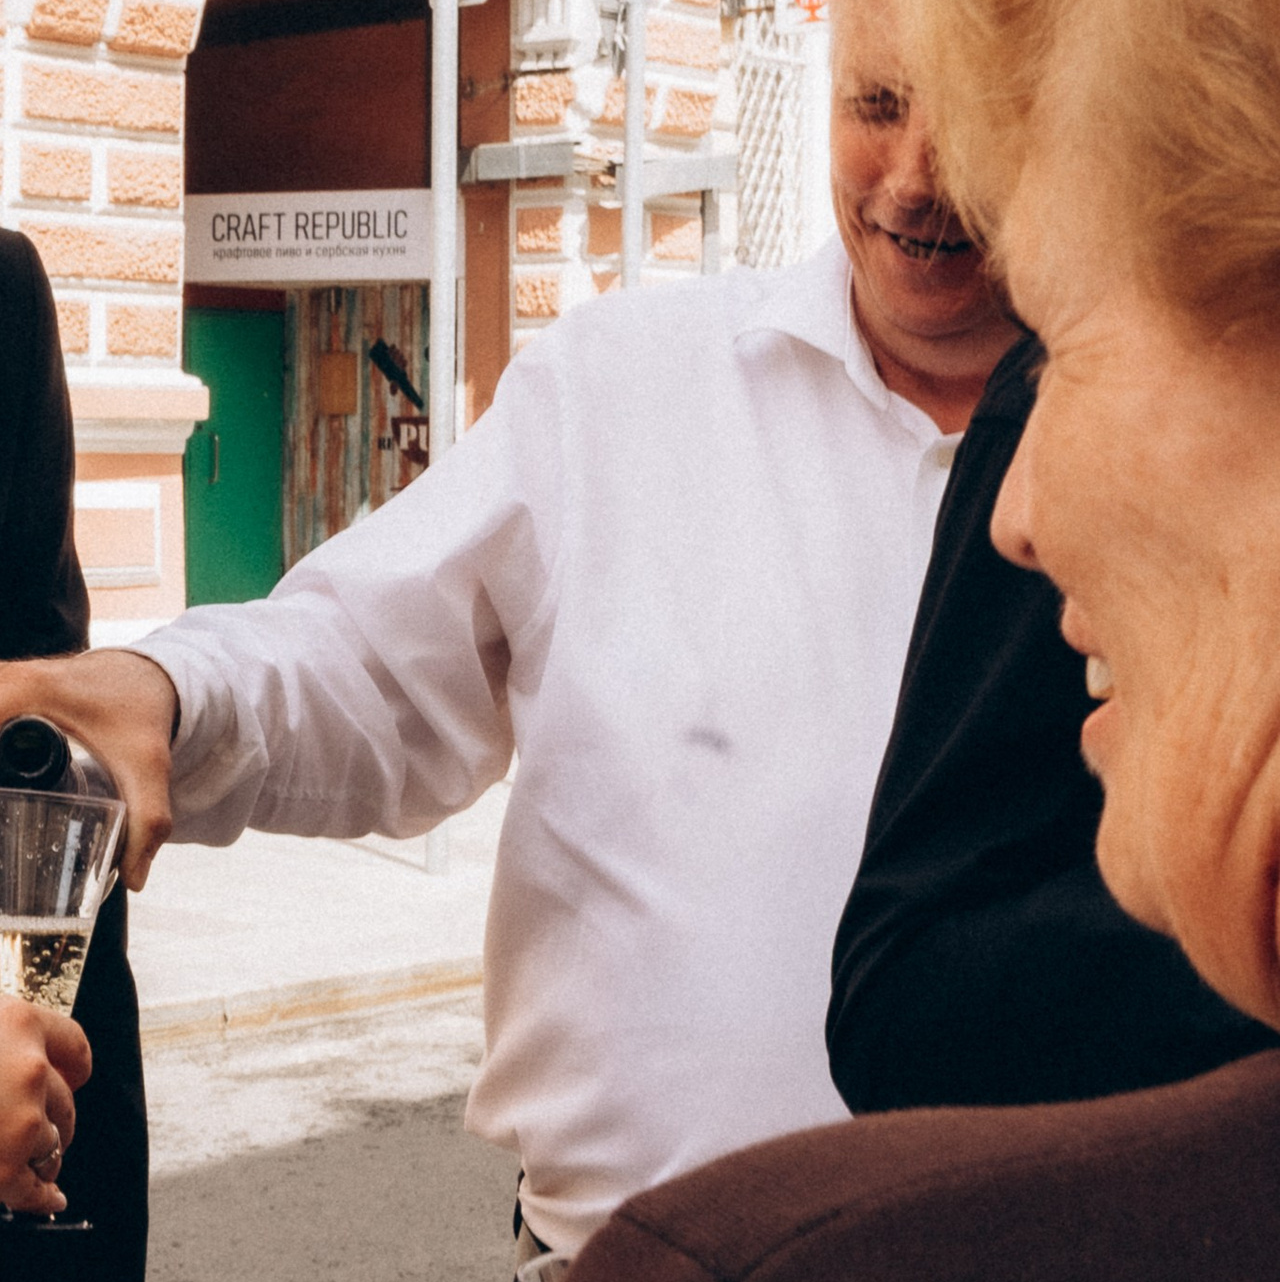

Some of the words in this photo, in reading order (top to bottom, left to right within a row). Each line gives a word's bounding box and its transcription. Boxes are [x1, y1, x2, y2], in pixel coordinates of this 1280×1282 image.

[212, 212, 286, 242] CRAFT
[295, 209, 408, 240] REPUBLIC
[213, 246, 272, 261] крафтовое
[275, 247, 302, 258] пиво
[305, 248, 312, 257] и
[315, 245, 369, 260] сербская
[373, 245, 406, 258] кухня
